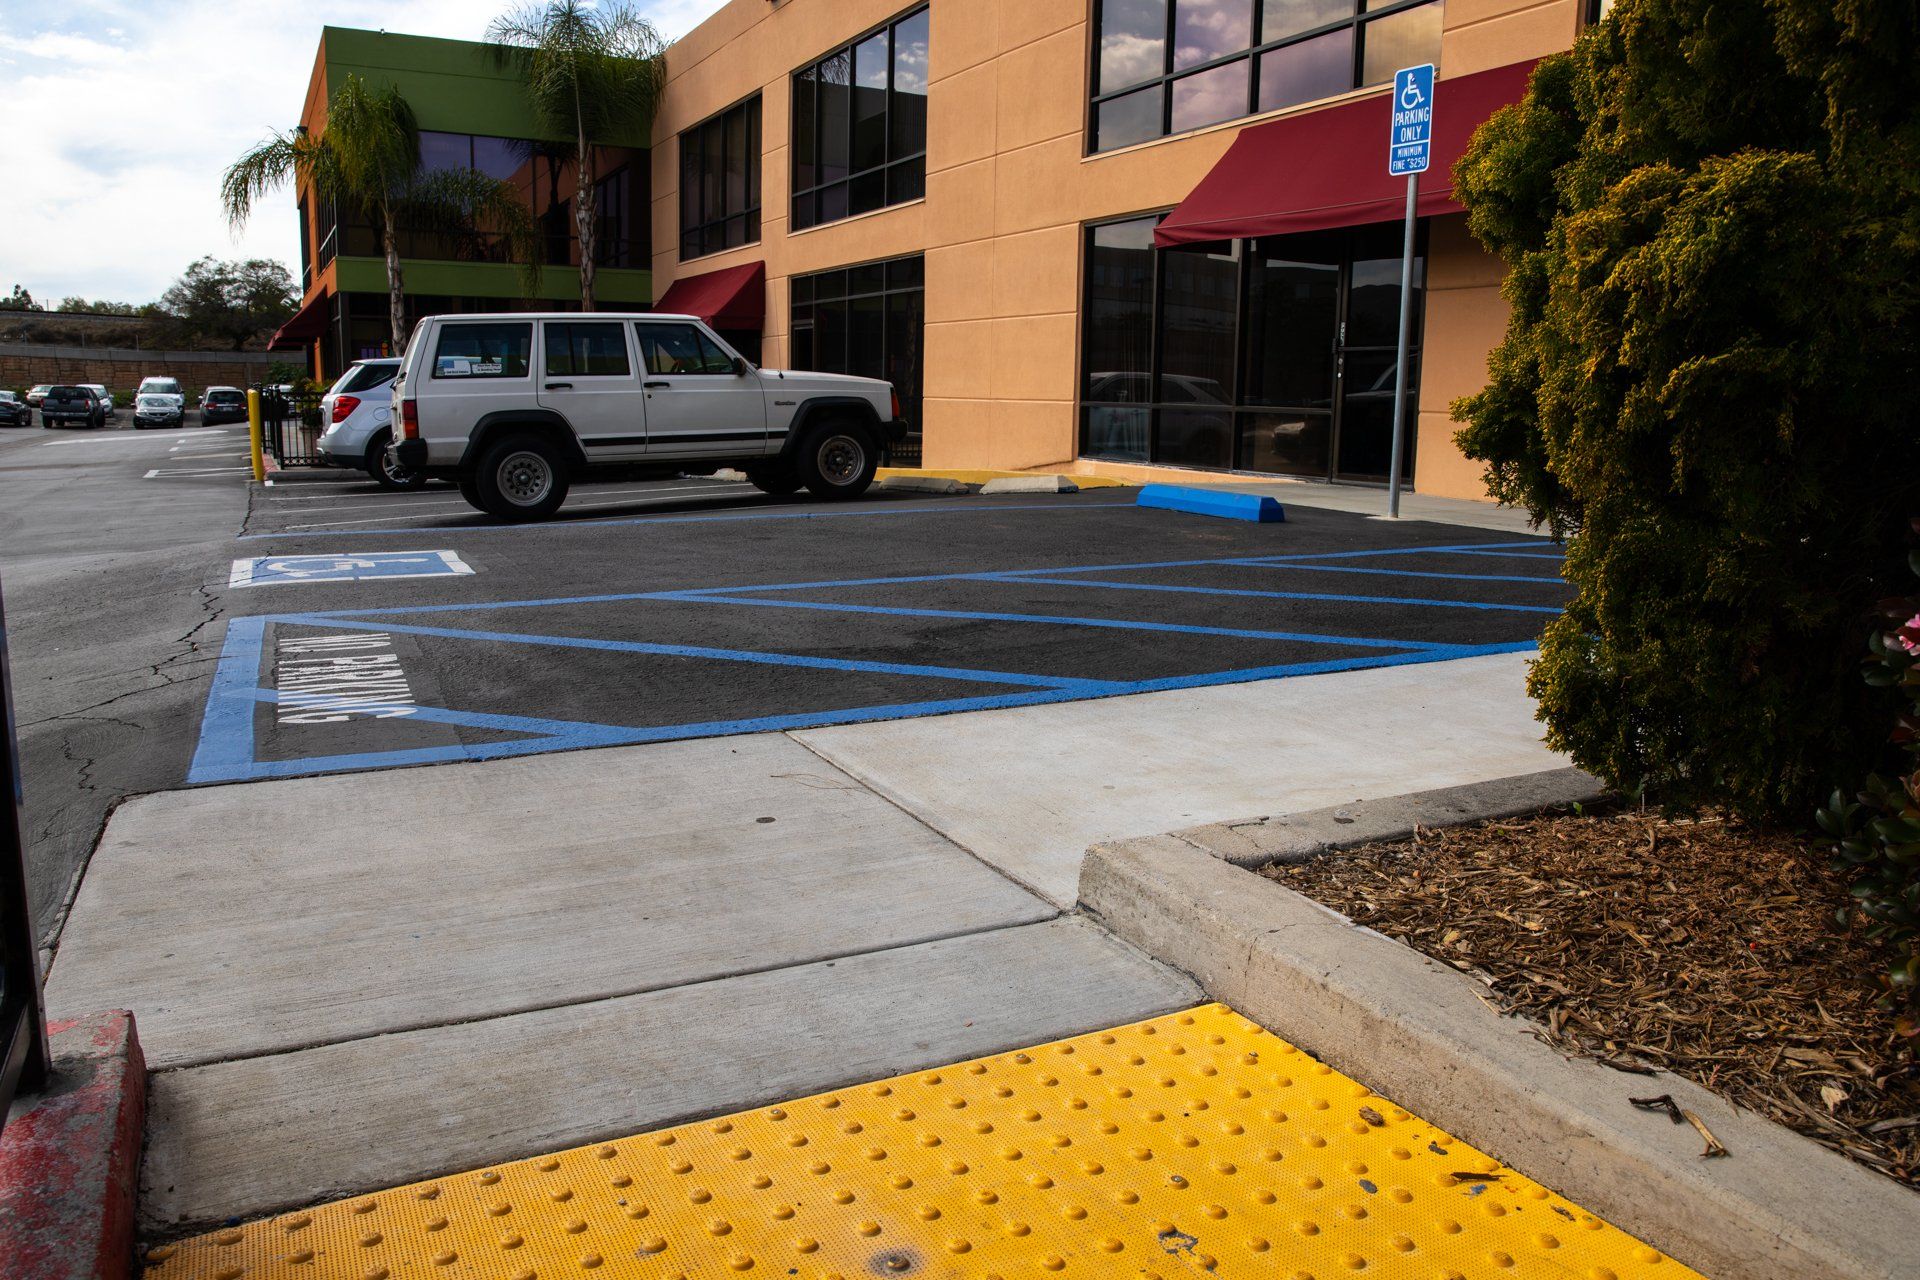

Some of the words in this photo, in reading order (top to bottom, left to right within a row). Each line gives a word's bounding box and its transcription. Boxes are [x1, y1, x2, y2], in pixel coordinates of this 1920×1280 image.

[1395, 107, 1430, 127] PARKING
[1400, 125, 1422, 142] ONLY
[1397, 145, 1423, 157] MINIMUM
[1392, 160, 1406, 170] FINE
[279, 633, 391, 653] NO
[278, 654, 418, 724] PARKING
